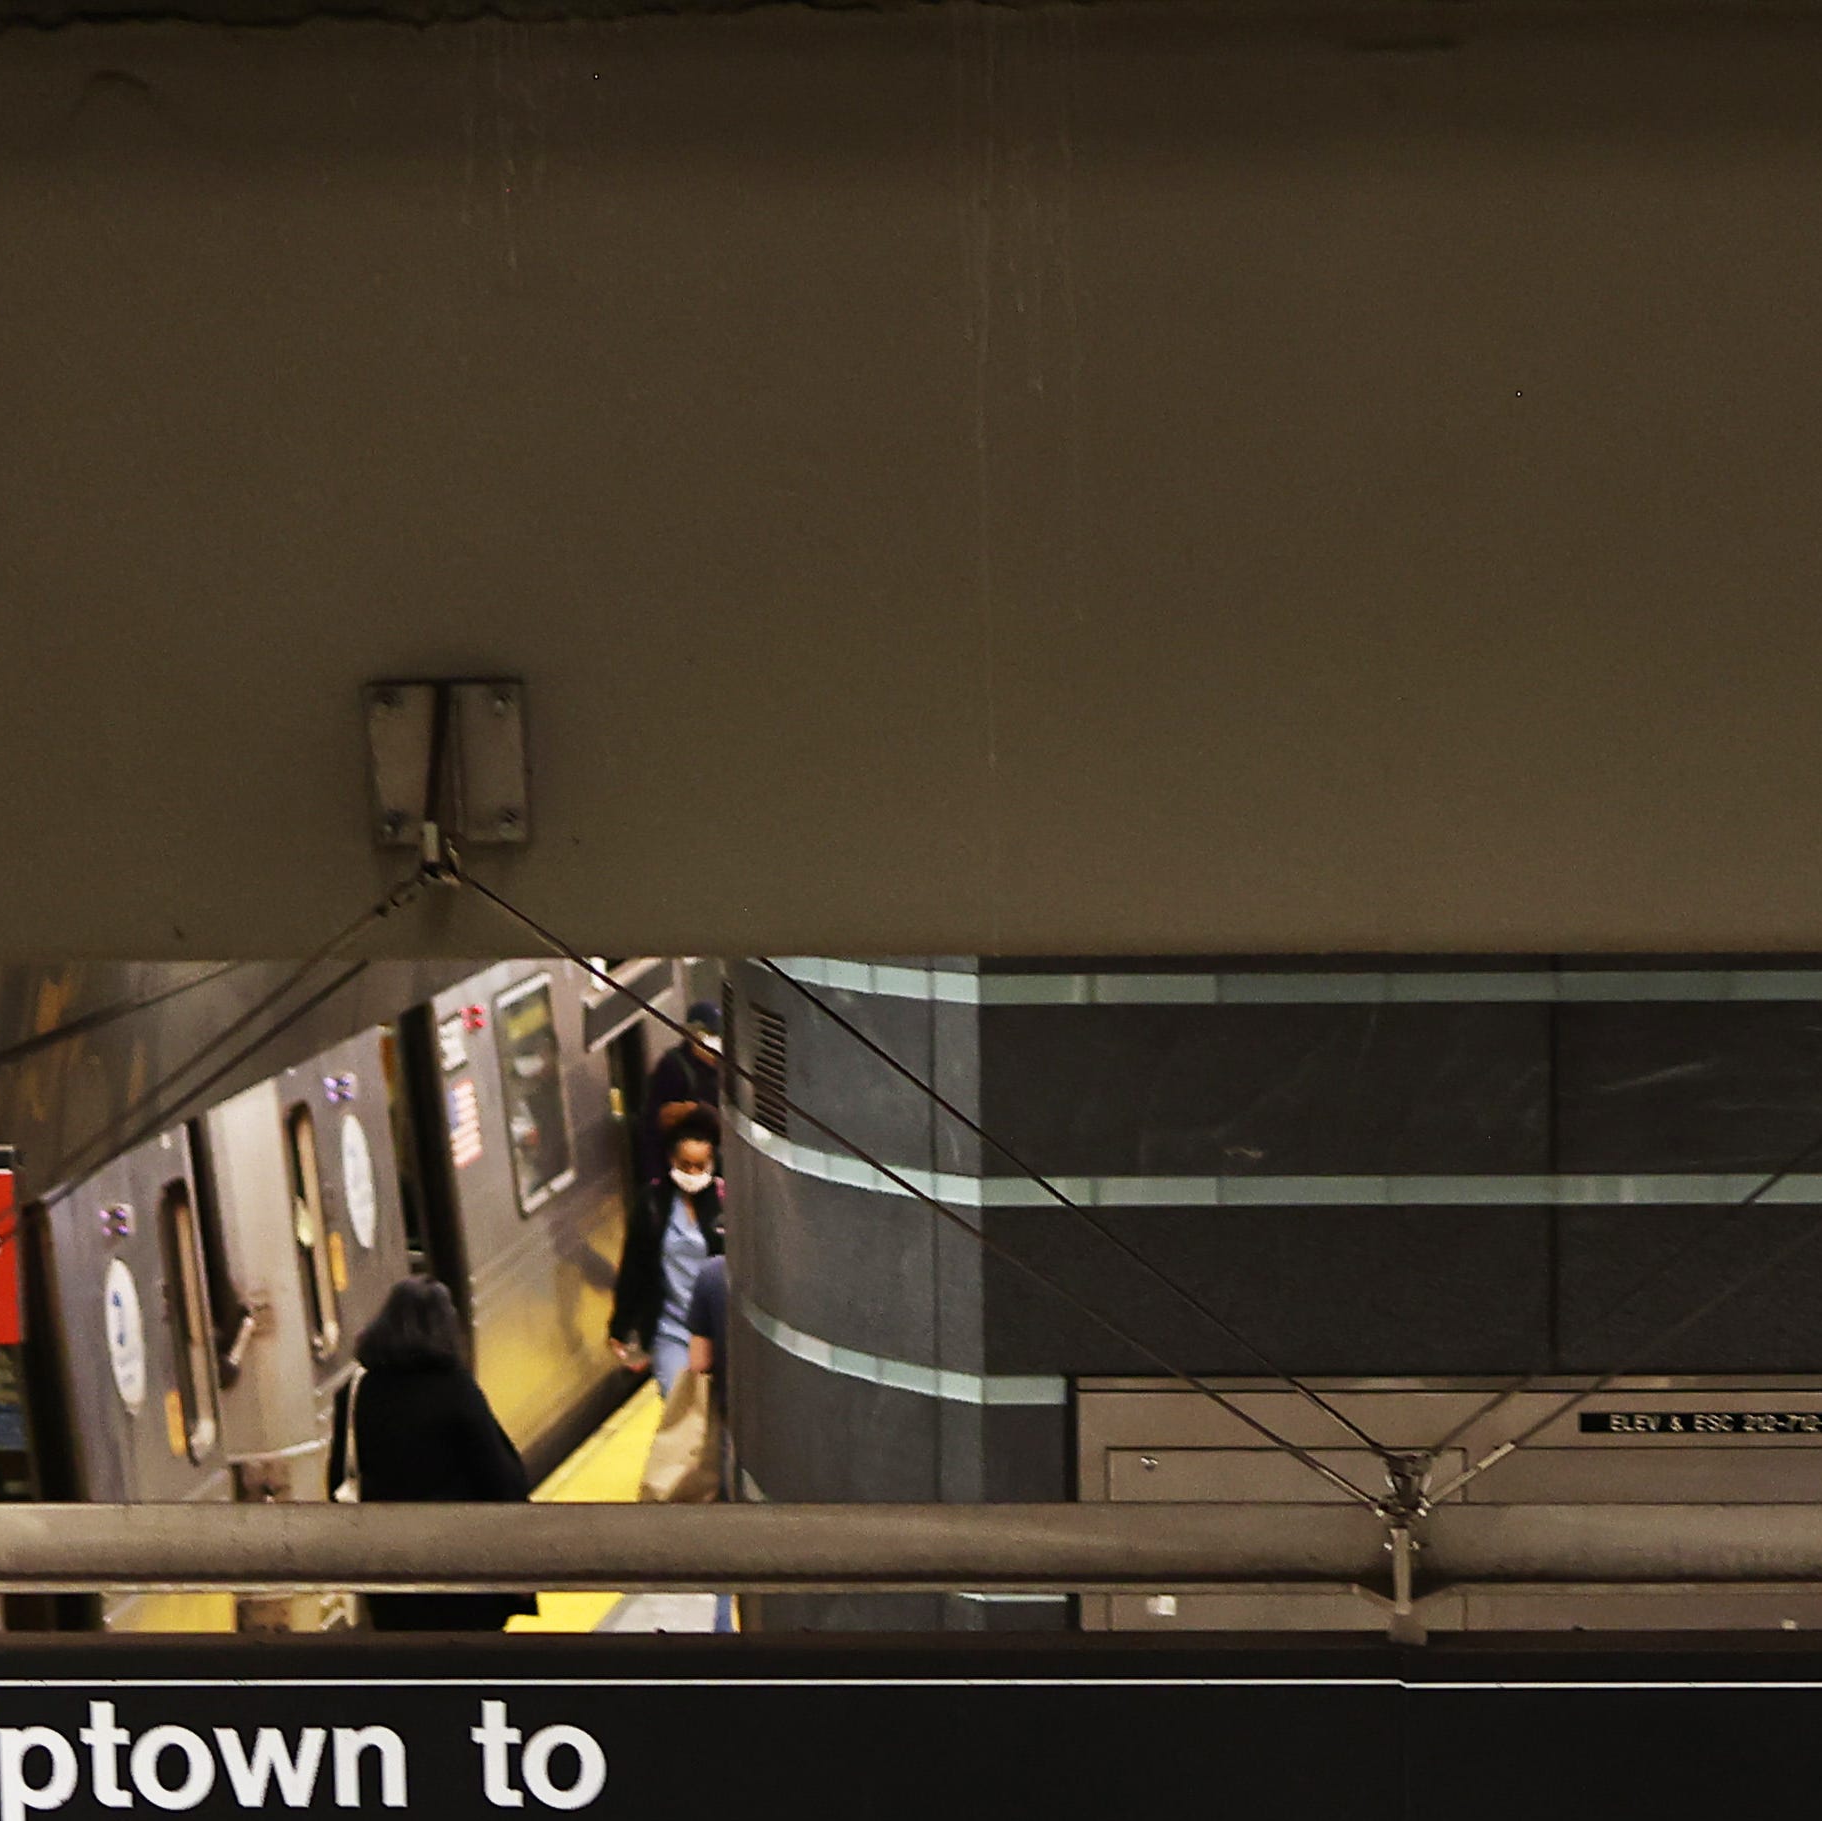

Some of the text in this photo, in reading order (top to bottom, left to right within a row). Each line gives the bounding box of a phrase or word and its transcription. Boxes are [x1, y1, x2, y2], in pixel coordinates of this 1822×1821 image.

[1609, 1414, 1661, 1432] ELEV
[1668, 1414, 1684, 1432] &
[1693, 1414, 1735, 1432] ESC
[471, 1700, 607, 1810] to
